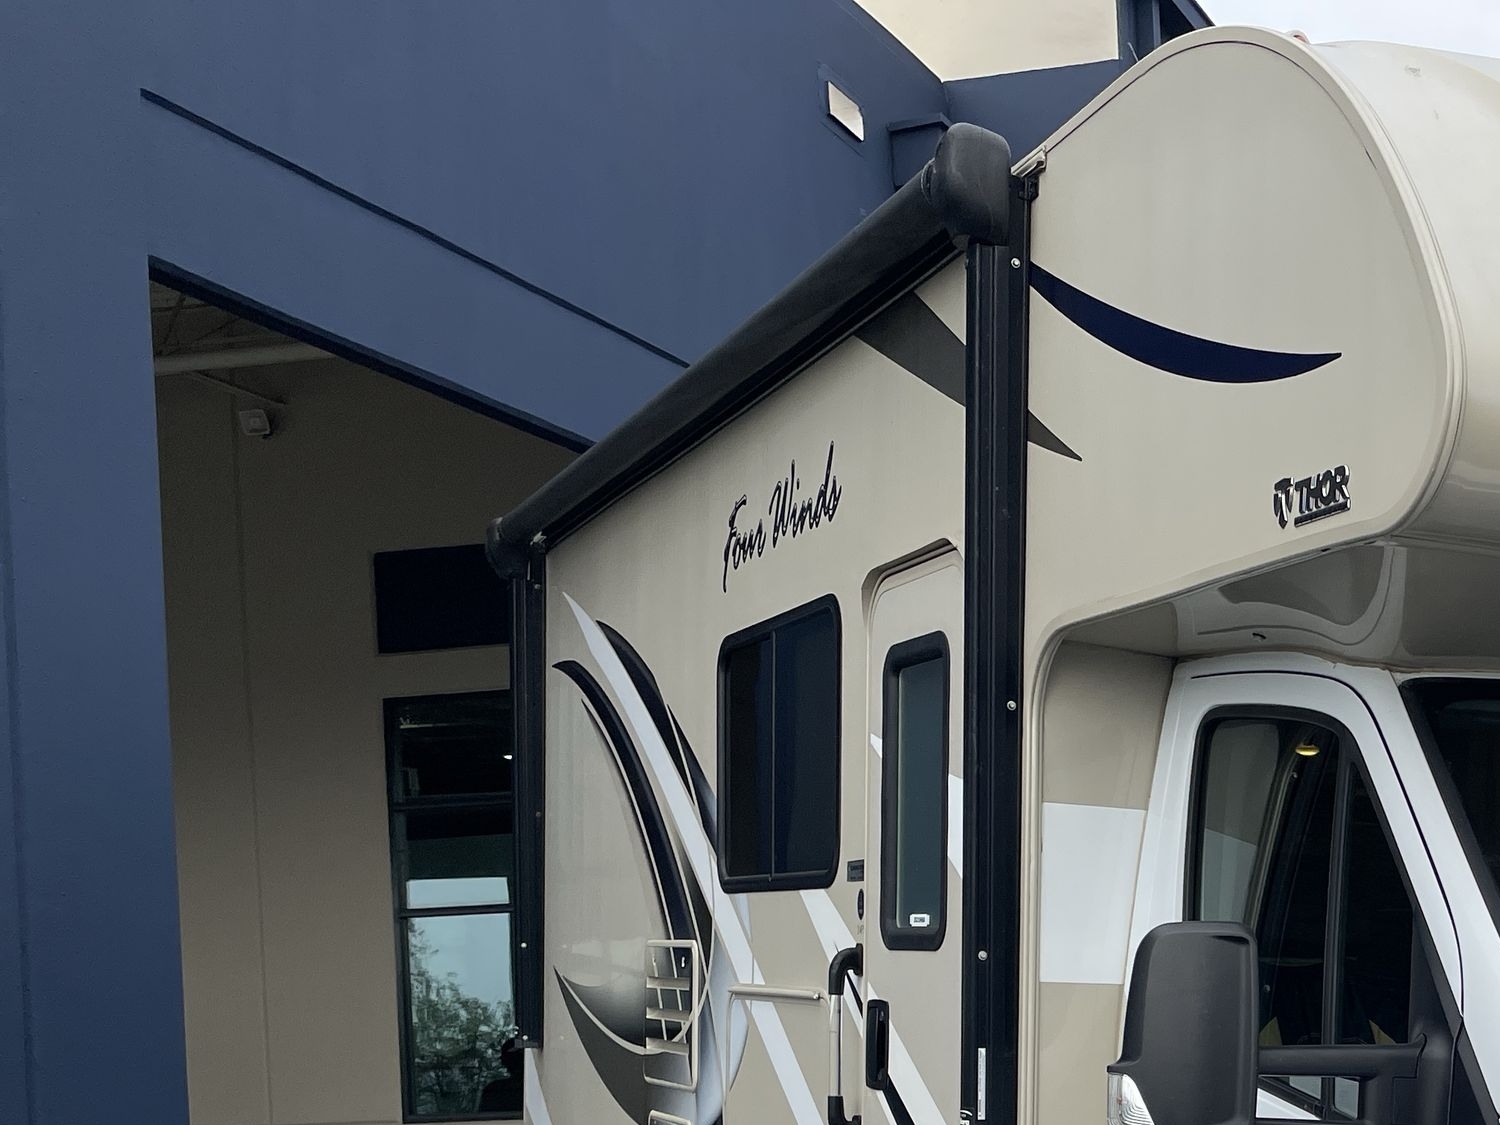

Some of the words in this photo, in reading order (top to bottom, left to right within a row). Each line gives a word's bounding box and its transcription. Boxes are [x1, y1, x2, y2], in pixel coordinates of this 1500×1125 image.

[722, 494, 767, 594] Four
[768, 440, 842, 549] Winds
[1294, 464, 1350, 514] THOR
